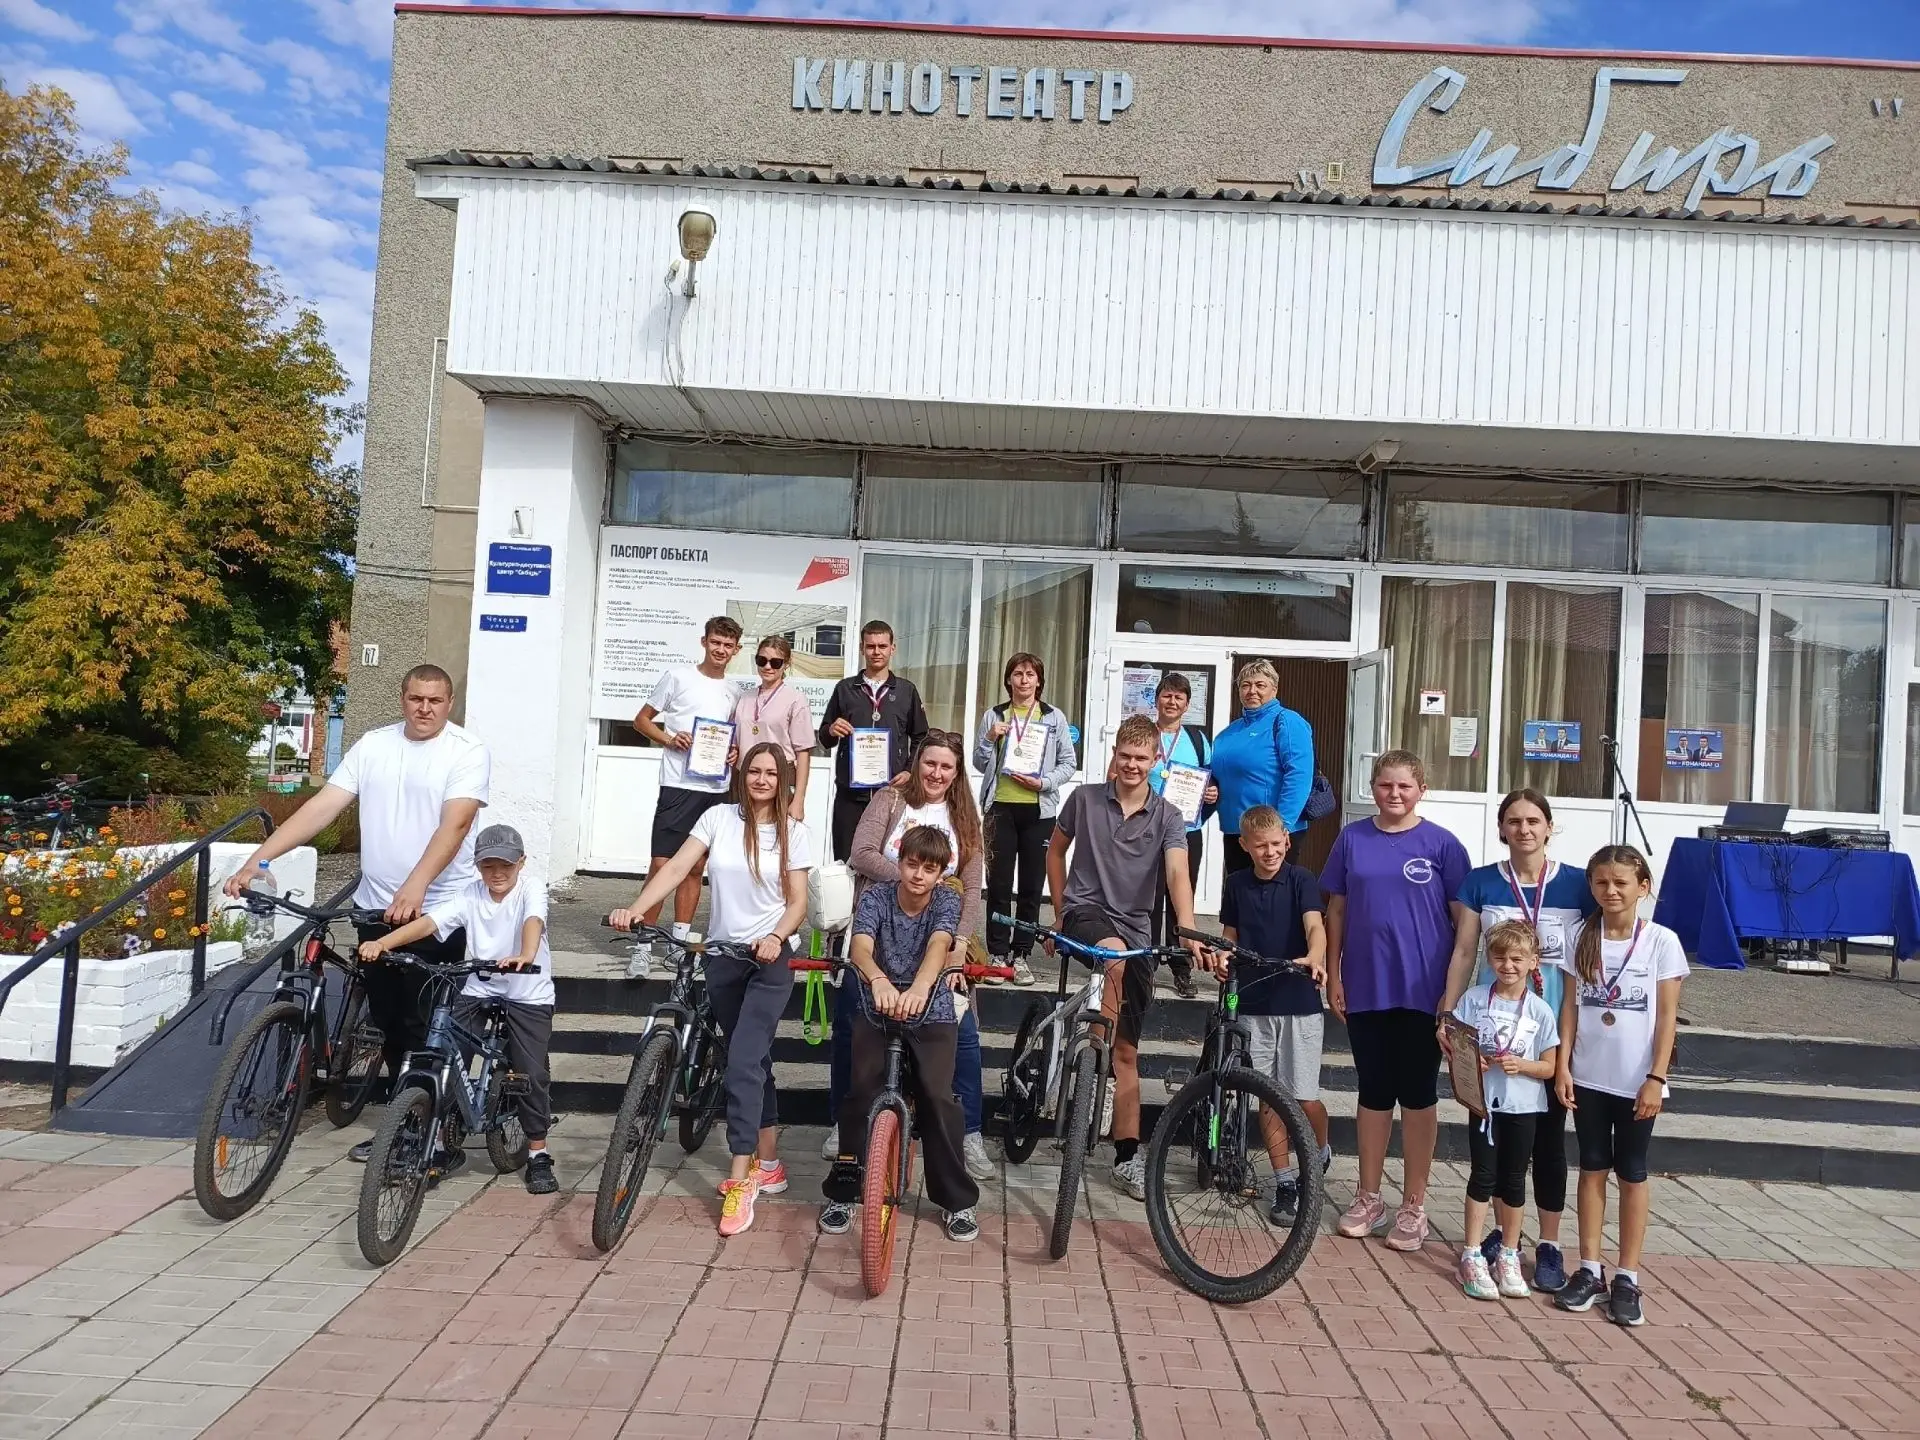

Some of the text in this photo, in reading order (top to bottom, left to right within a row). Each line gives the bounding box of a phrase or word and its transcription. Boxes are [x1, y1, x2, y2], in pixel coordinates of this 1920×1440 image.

[792, 57, 1134, 122] КИНОТЕАТР
[610, 544, 709, 563] ПАСПОРТ ОБЪЕКТА
[486, 615, 520, 624] Чехова
[365, 647, 376, 664] 67
[455, 1050, 475, 1105] TRAVEL
